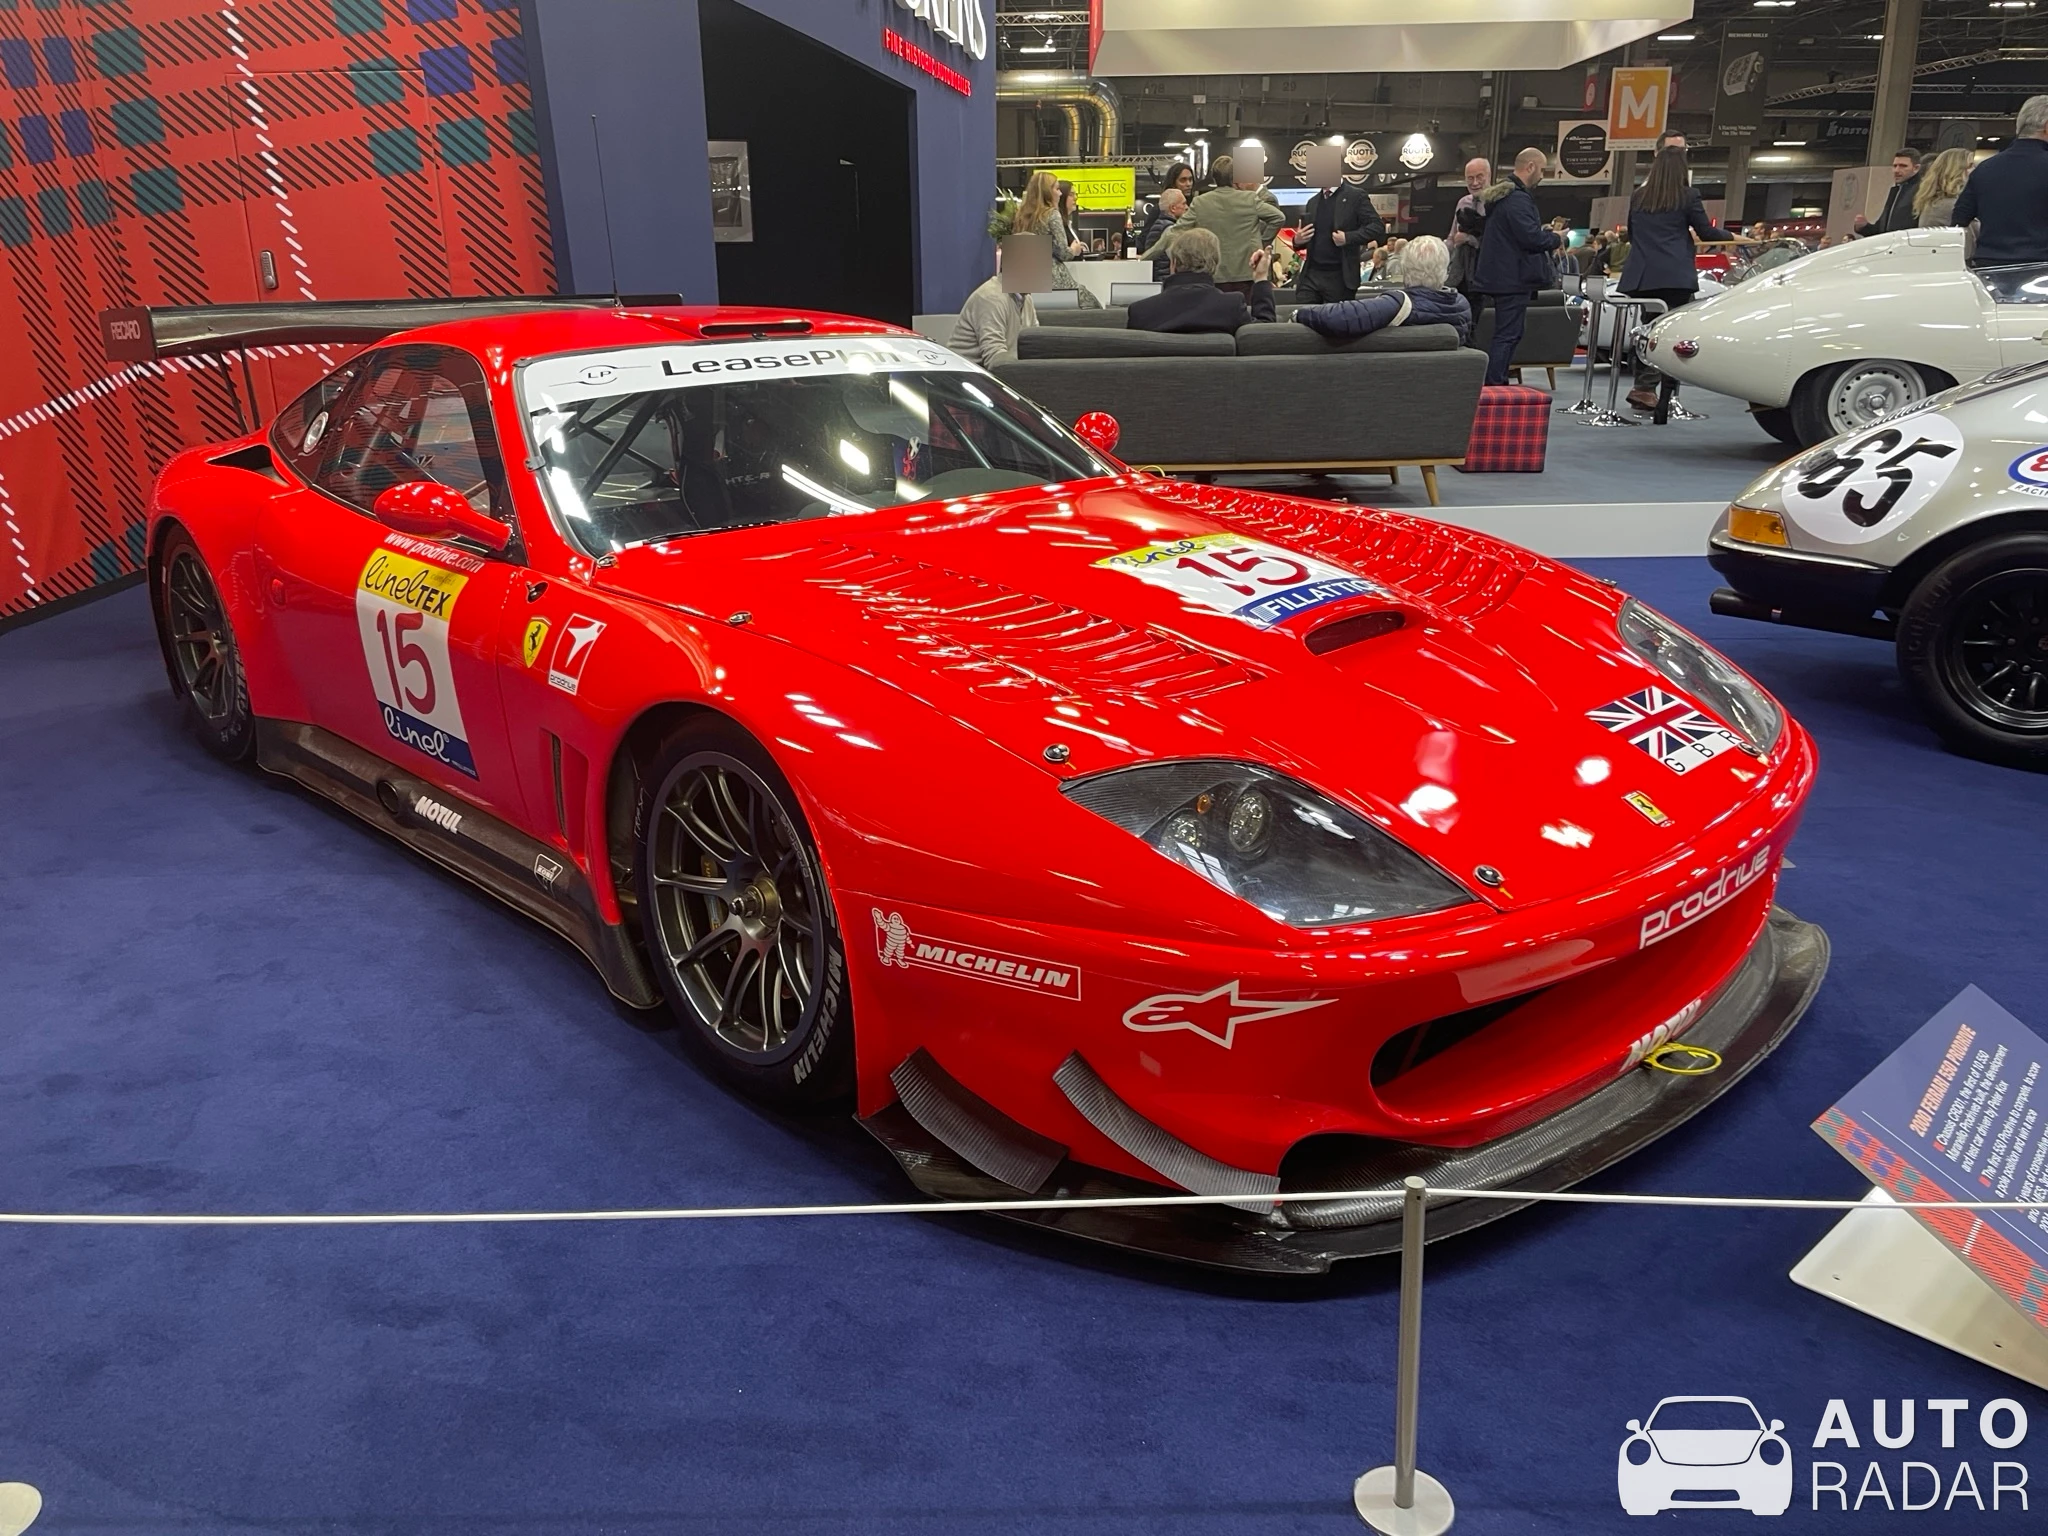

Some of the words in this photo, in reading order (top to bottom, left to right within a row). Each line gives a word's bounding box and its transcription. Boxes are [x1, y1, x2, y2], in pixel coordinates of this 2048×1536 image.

[885, 27, 904, 57] FINE
[1618, 85, 1659, 129] M
[1347, 147, 1376, 156] RUOTE
[1074, 182, 1128, 195] LASSICS
[109, 319, 141, 340] RECARO
[586, 367, 612, 381] LP
[384, 532, 485, 574] www.prodrive.com
[1175, 548, 1312, 597] 15
[376, 608, 436, 716] 15
[414, 795, 463, 834] MOTUL
[1639, 844, 1771, 950] prodrive
[915, 942, 1072, 988] MICHELIN
[792, 950, 844, 1085] MICHELIN
[1946, 1024, 1976, 1066] PRODRIVE
[1938, 1060, 1958, 1081] 550
[1920, 1075, 1950, 1115] FERRARI
[1909, 1109, 1933, 1137] 2000
